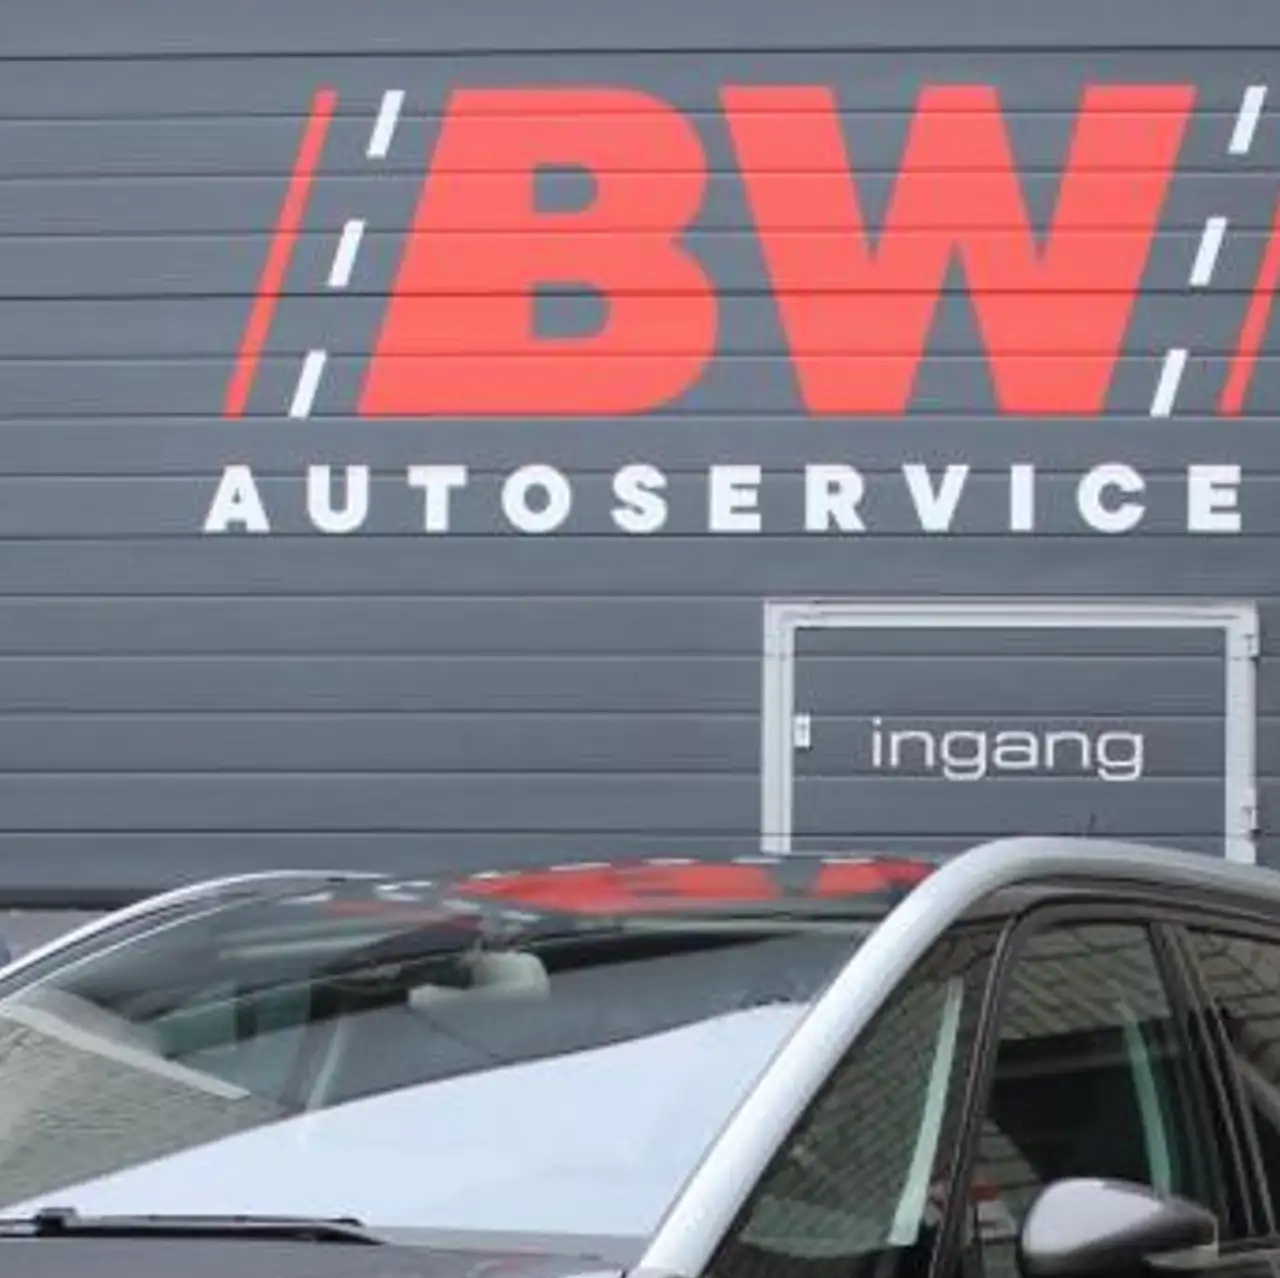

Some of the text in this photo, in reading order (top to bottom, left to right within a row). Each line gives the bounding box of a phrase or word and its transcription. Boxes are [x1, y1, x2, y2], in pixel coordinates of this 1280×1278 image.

[356, 84, 1198, 417] BW
[203, 463, 1242, 532] AUTOSERVICE
[871, 716, 1145, 782] ingang
